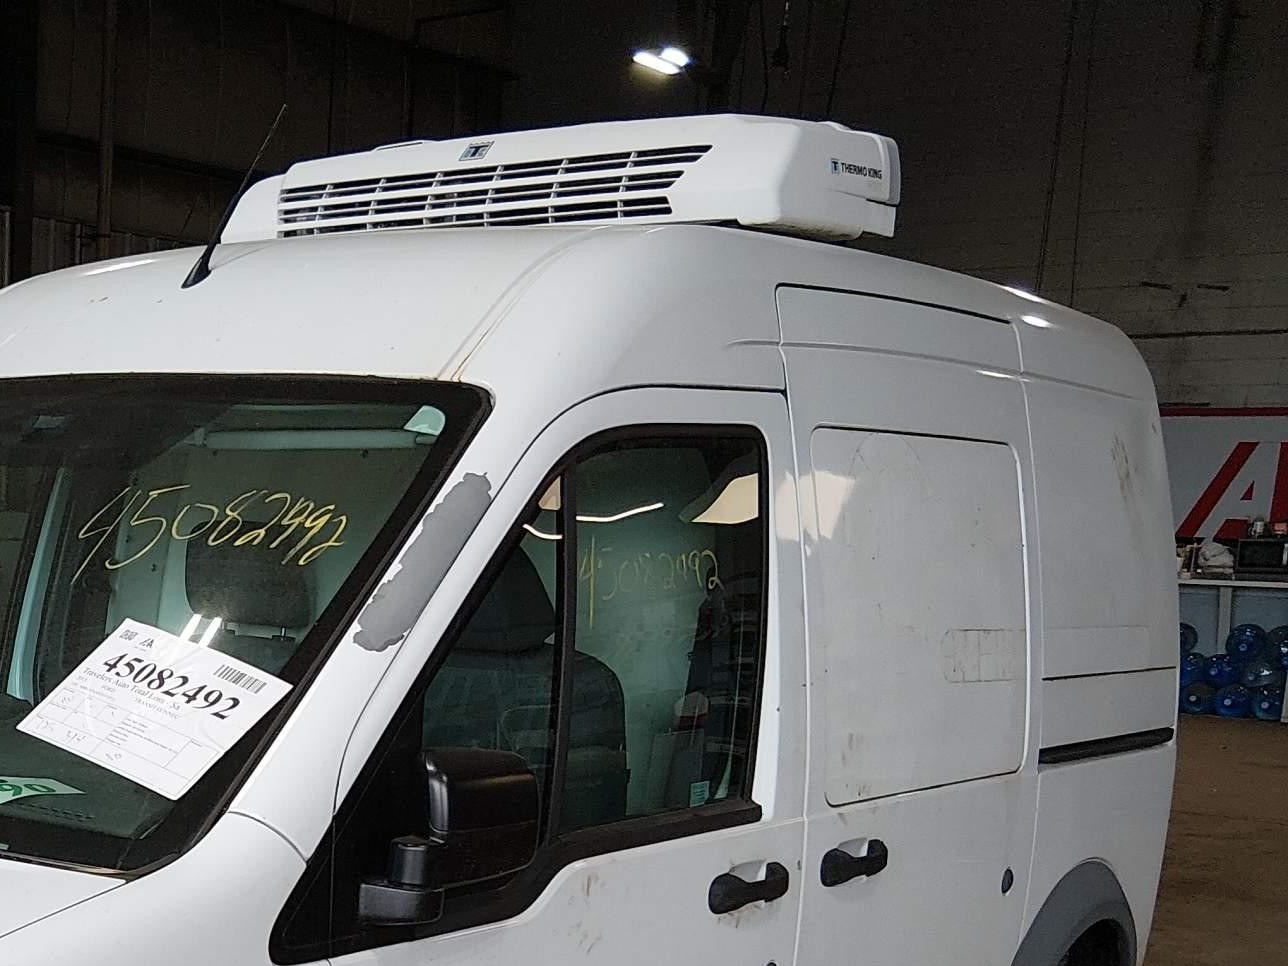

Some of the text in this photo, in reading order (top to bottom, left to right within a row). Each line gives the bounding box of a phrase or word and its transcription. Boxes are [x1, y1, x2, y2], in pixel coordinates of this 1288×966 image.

[841, 162, 868, 177] THERMO
[868, 167, 883, 180] KING
[71, 485, 348, 585] 45082492
[83, 667, 112, 684] Travelers
[130, 685, 149, 697] Total
[103, 653, 240, 720] 45082492
